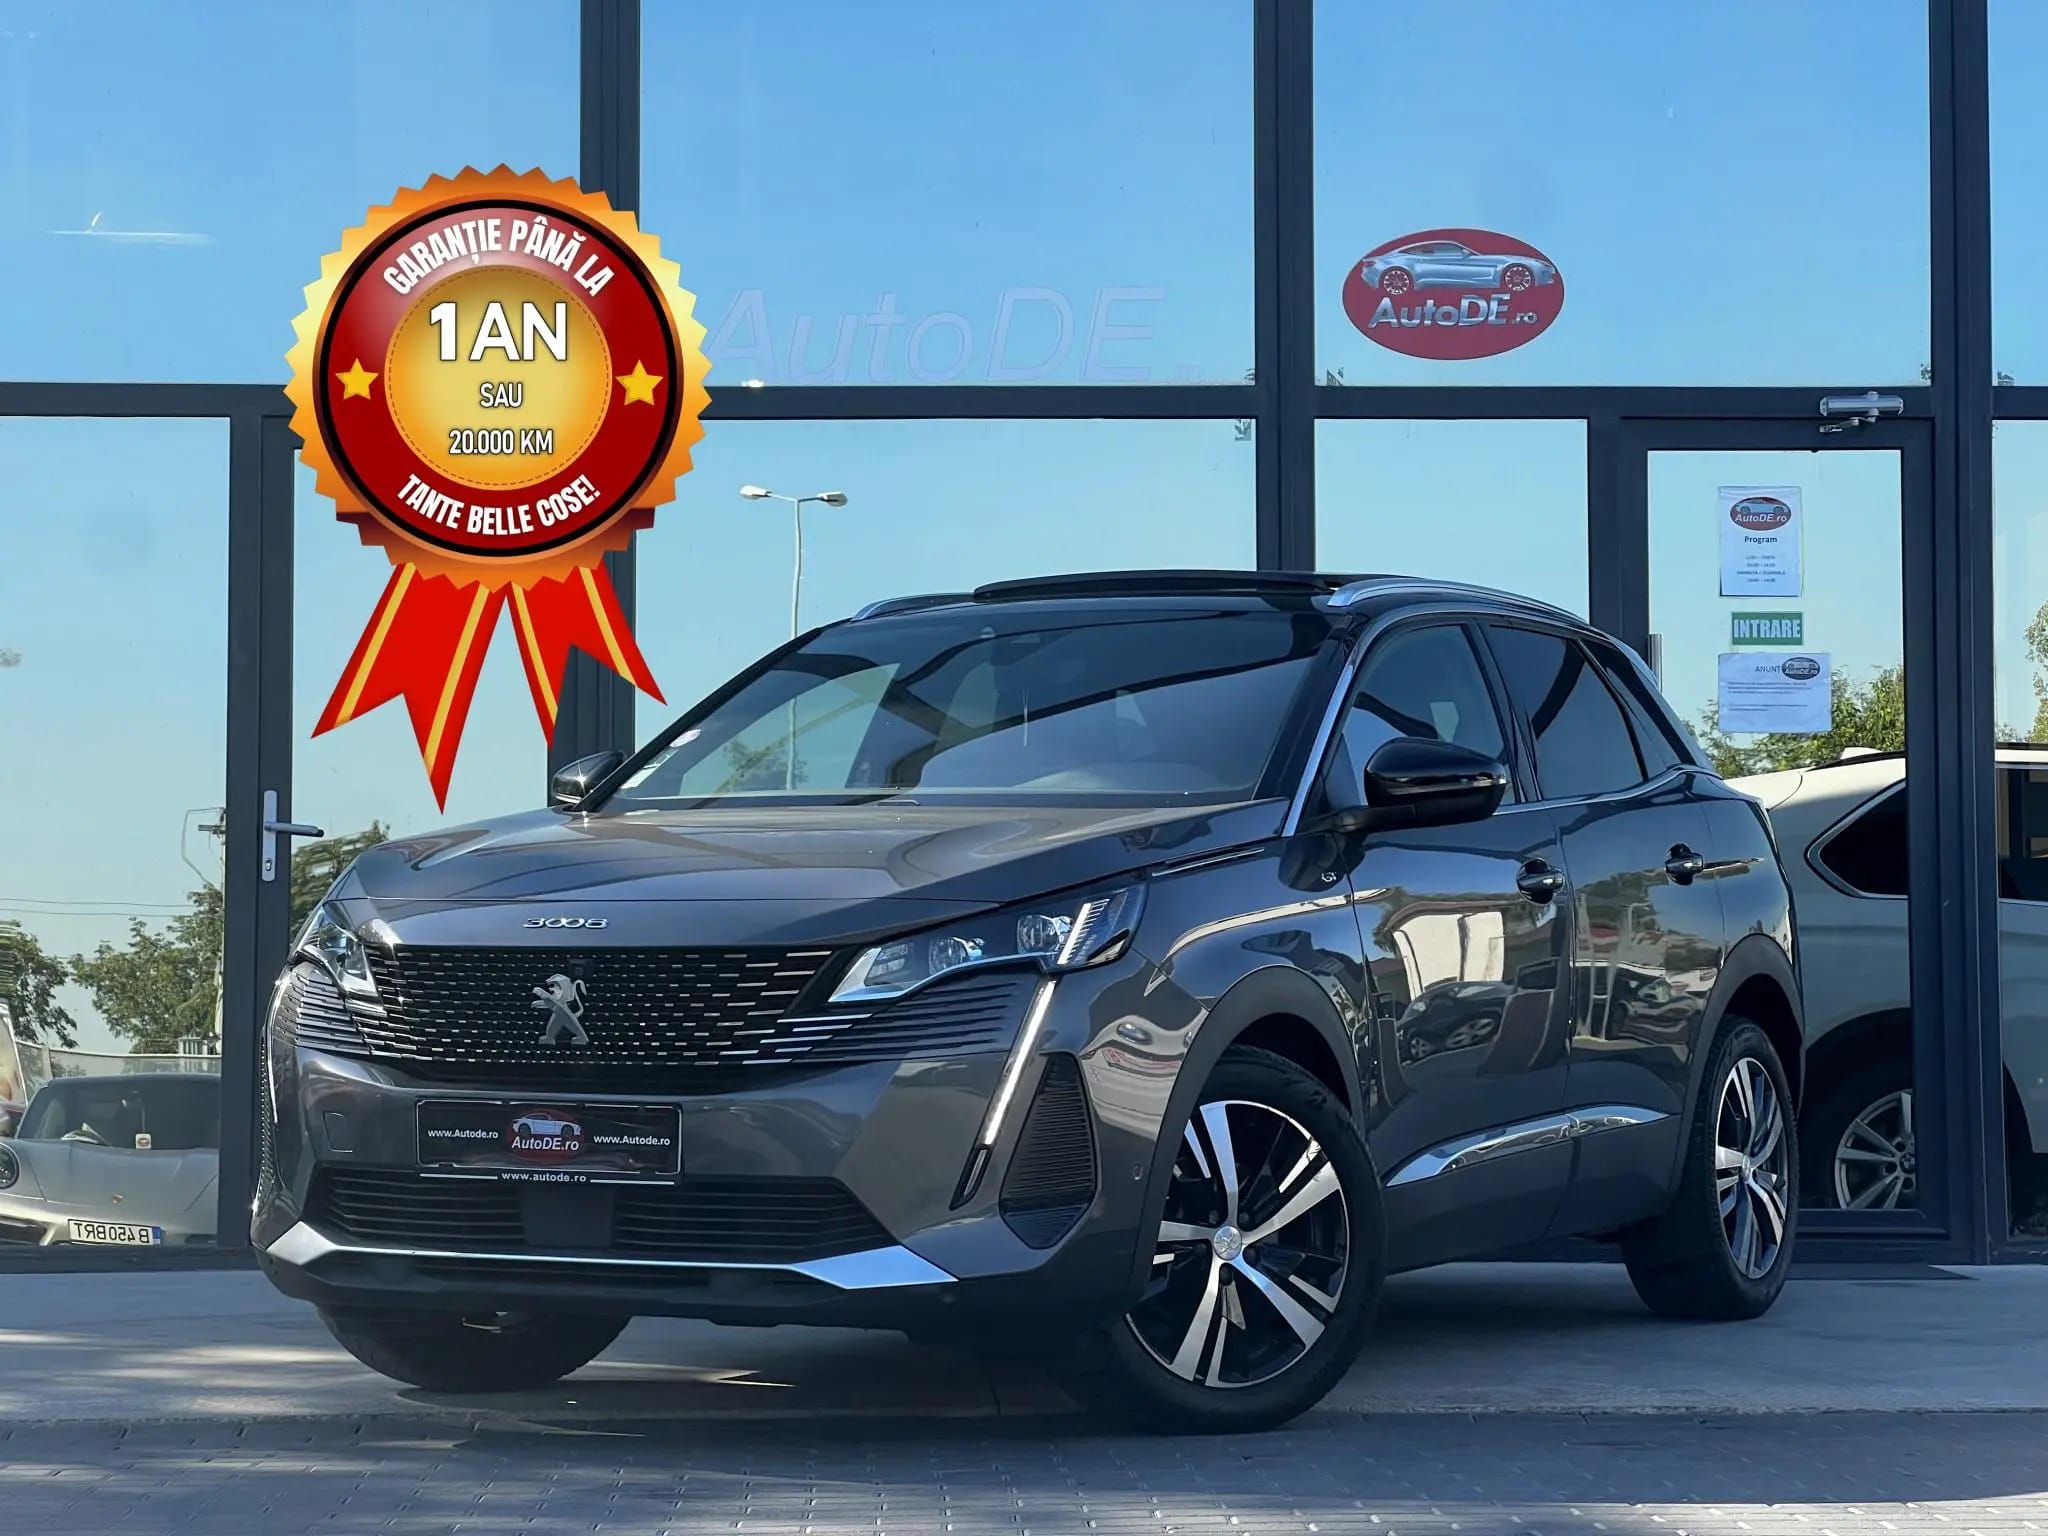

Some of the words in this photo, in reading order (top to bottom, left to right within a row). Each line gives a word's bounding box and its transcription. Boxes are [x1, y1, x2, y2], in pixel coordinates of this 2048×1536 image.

[1744, 535, 1778, 545] Program
[1733, 619, 1801, 639] INTRARE
[523, 917, 609, 929] 3008
[511, 1136, 580, 1152] AutoDE.ro
[501, 1171, 587, 1183] www.autode.ro
